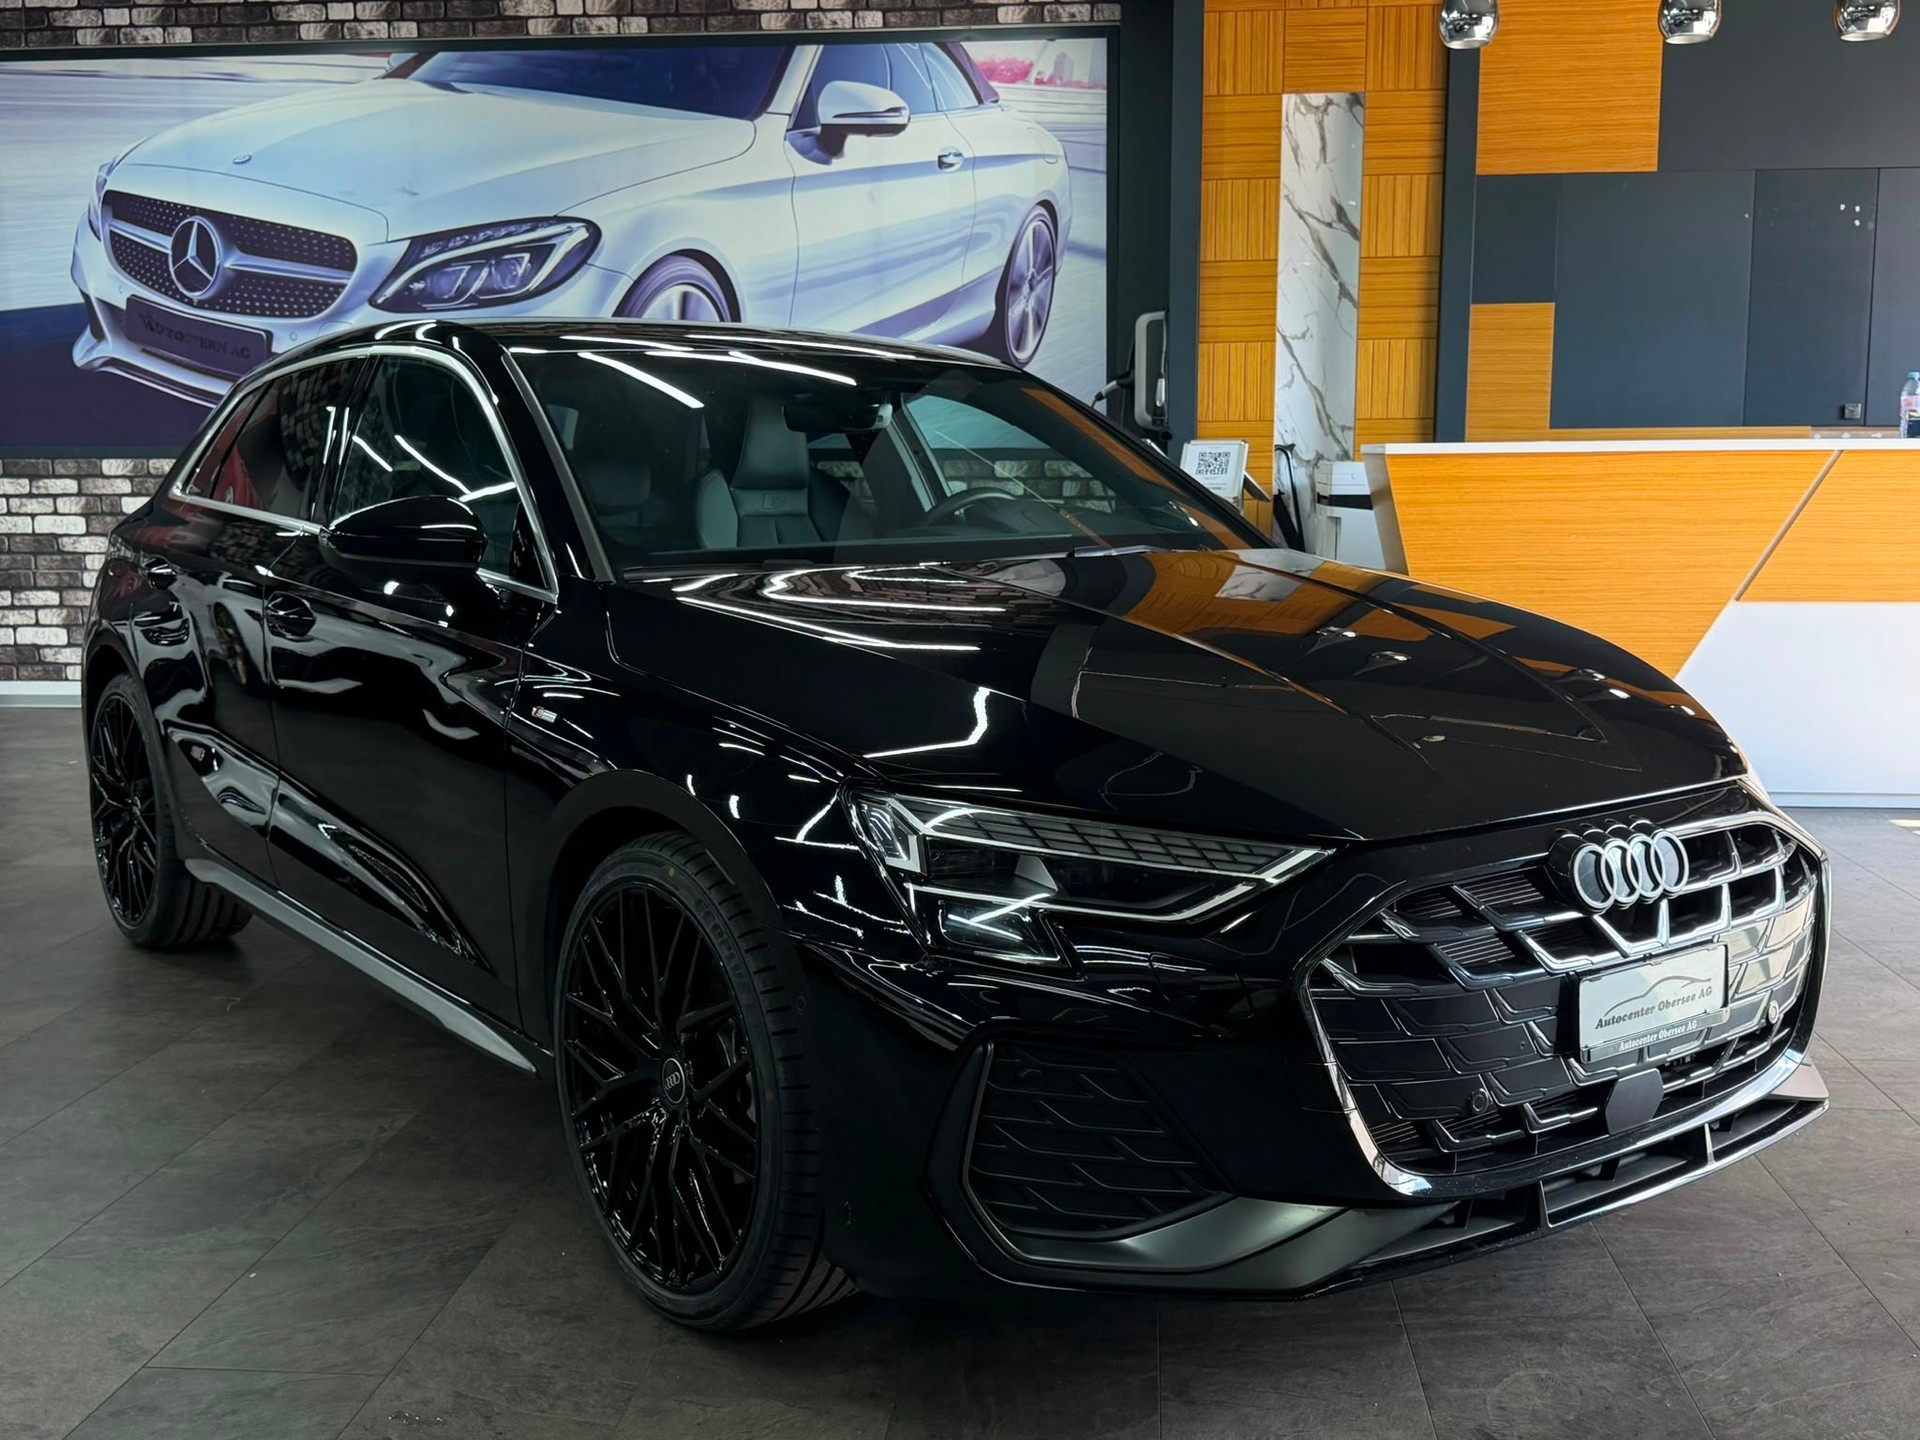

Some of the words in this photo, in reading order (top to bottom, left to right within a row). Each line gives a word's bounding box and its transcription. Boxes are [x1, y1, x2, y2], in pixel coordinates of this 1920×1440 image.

[142, 318, 228, 353] AUTOSTERN
[231, 345, 250, 359] AG
[1595, 1006, 1656, 1029] Autocenter
[1657, 993, 1697, 1012] Obersee
[1698, 986, 1712, 999] AG
[1619, 1033, 1658, 1051] Autocenter
[1659, 1024, 1686, 1040] Obersee
[1687, 1020, 1698, 1032] AG
